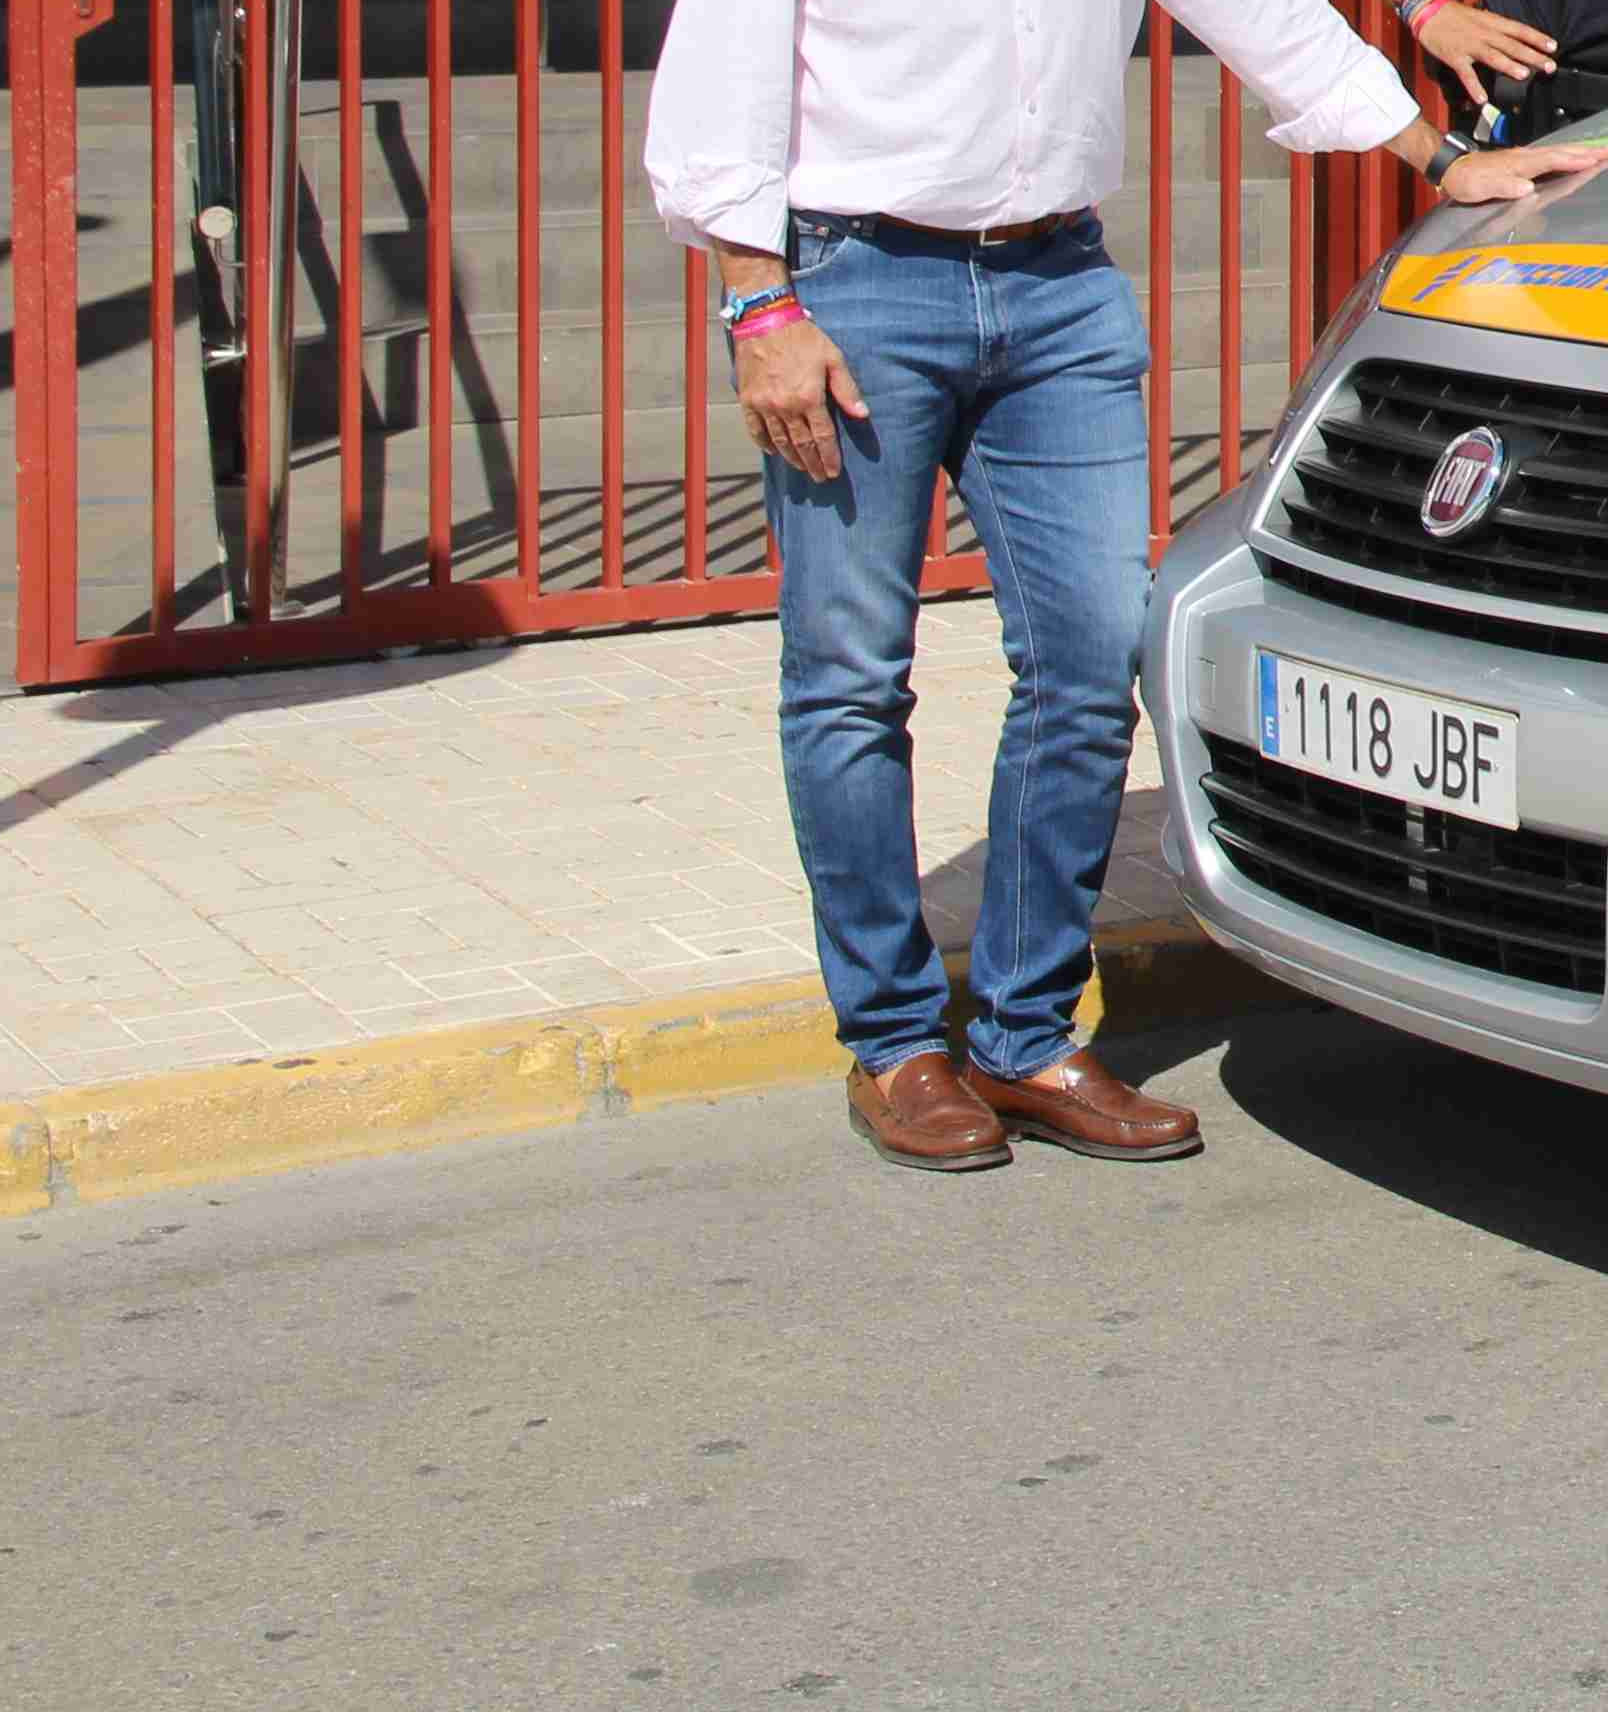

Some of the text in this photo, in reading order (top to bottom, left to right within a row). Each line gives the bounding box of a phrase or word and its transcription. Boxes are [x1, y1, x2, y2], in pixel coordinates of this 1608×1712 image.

[1433, 455, 1489, 506] FIAT
[1264, 676, 1500, 805] E 1118 JBF
